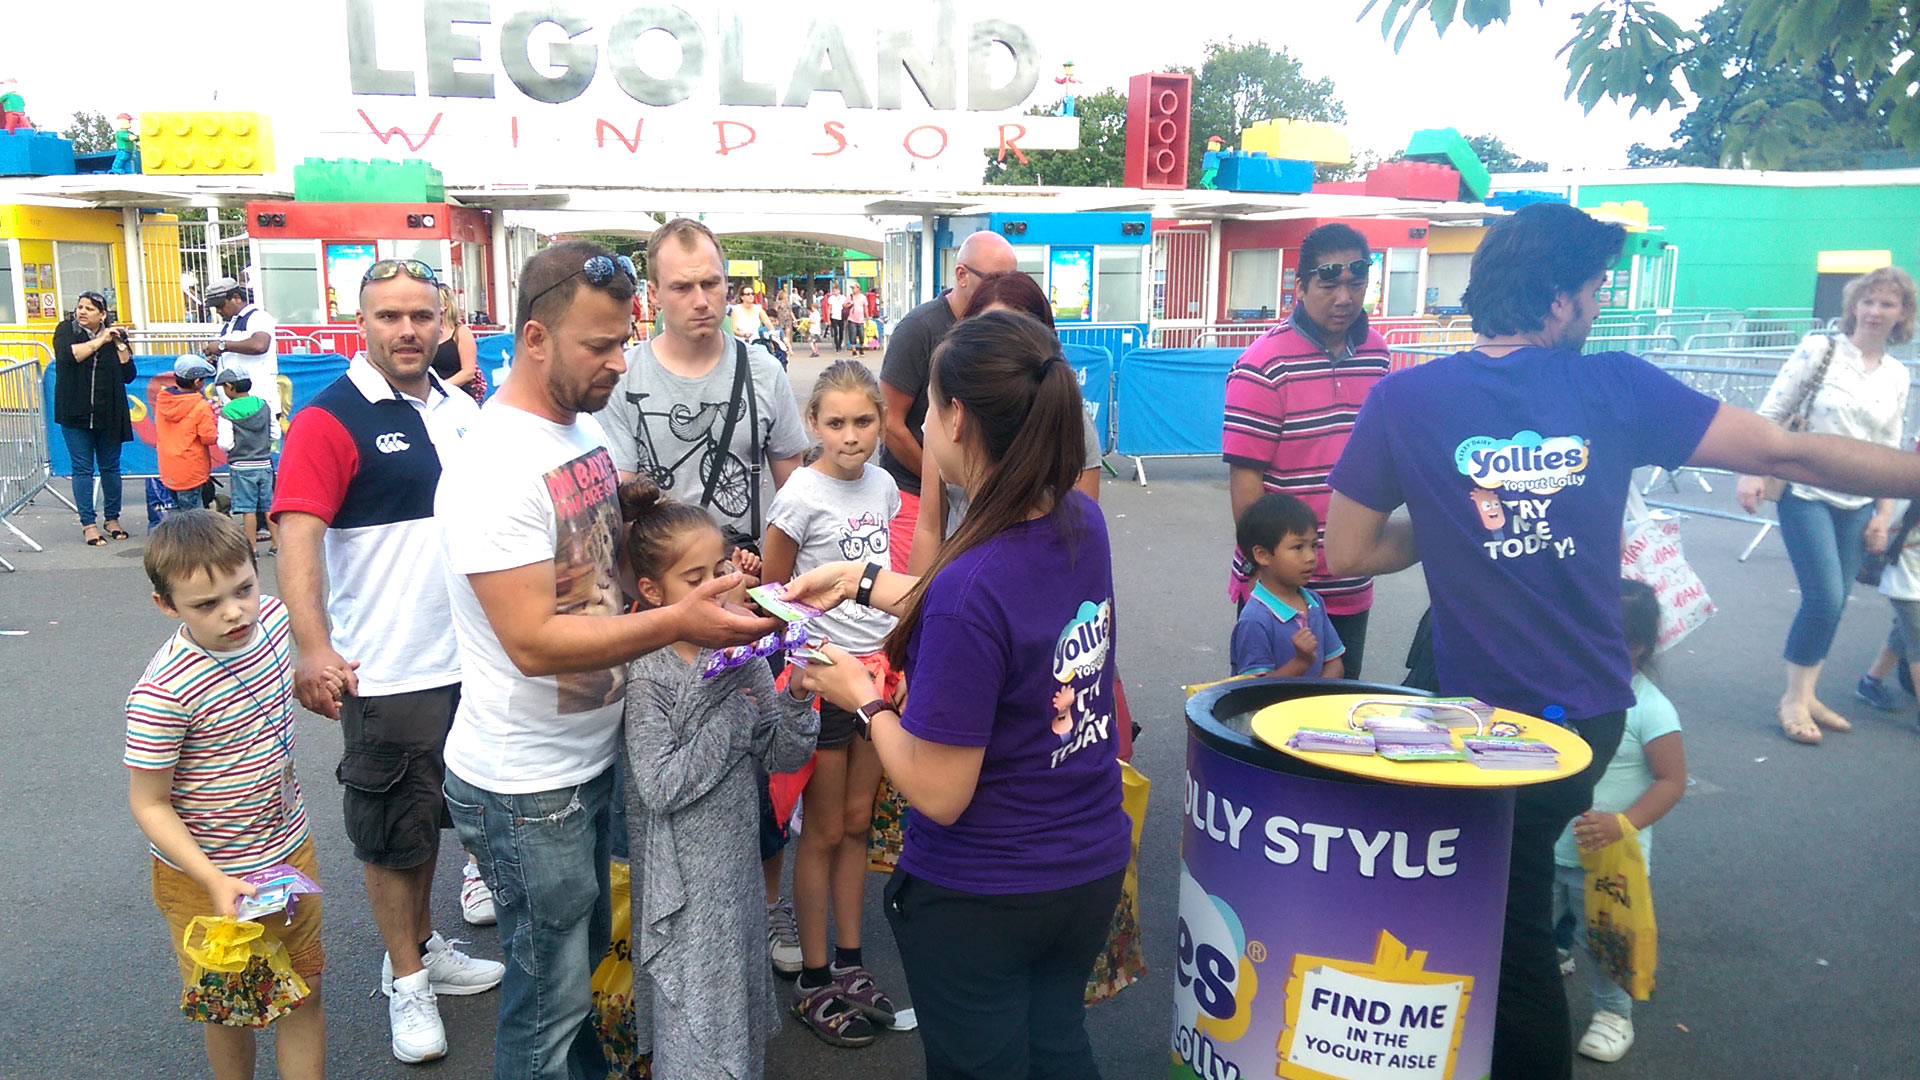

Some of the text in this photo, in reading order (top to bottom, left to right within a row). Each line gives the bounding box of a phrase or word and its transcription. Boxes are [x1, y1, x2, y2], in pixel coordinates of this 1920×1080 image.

[346, 0, 1040, 111] LEGOLAND
[357, 108, 1028, 164] WINDSOR
[1502, 474, 1586, 492] Yogurt Lolly
[1484, 537, 1576, 560] TODY!
[1264, 815, 1460, 879] STYLE
[1312, 987, 1448, 1029] FIND ME
[1305, 1035, 1437, 1069] YOGURT AISLE
[1347, 1026, 1409, 1048] IN THE
